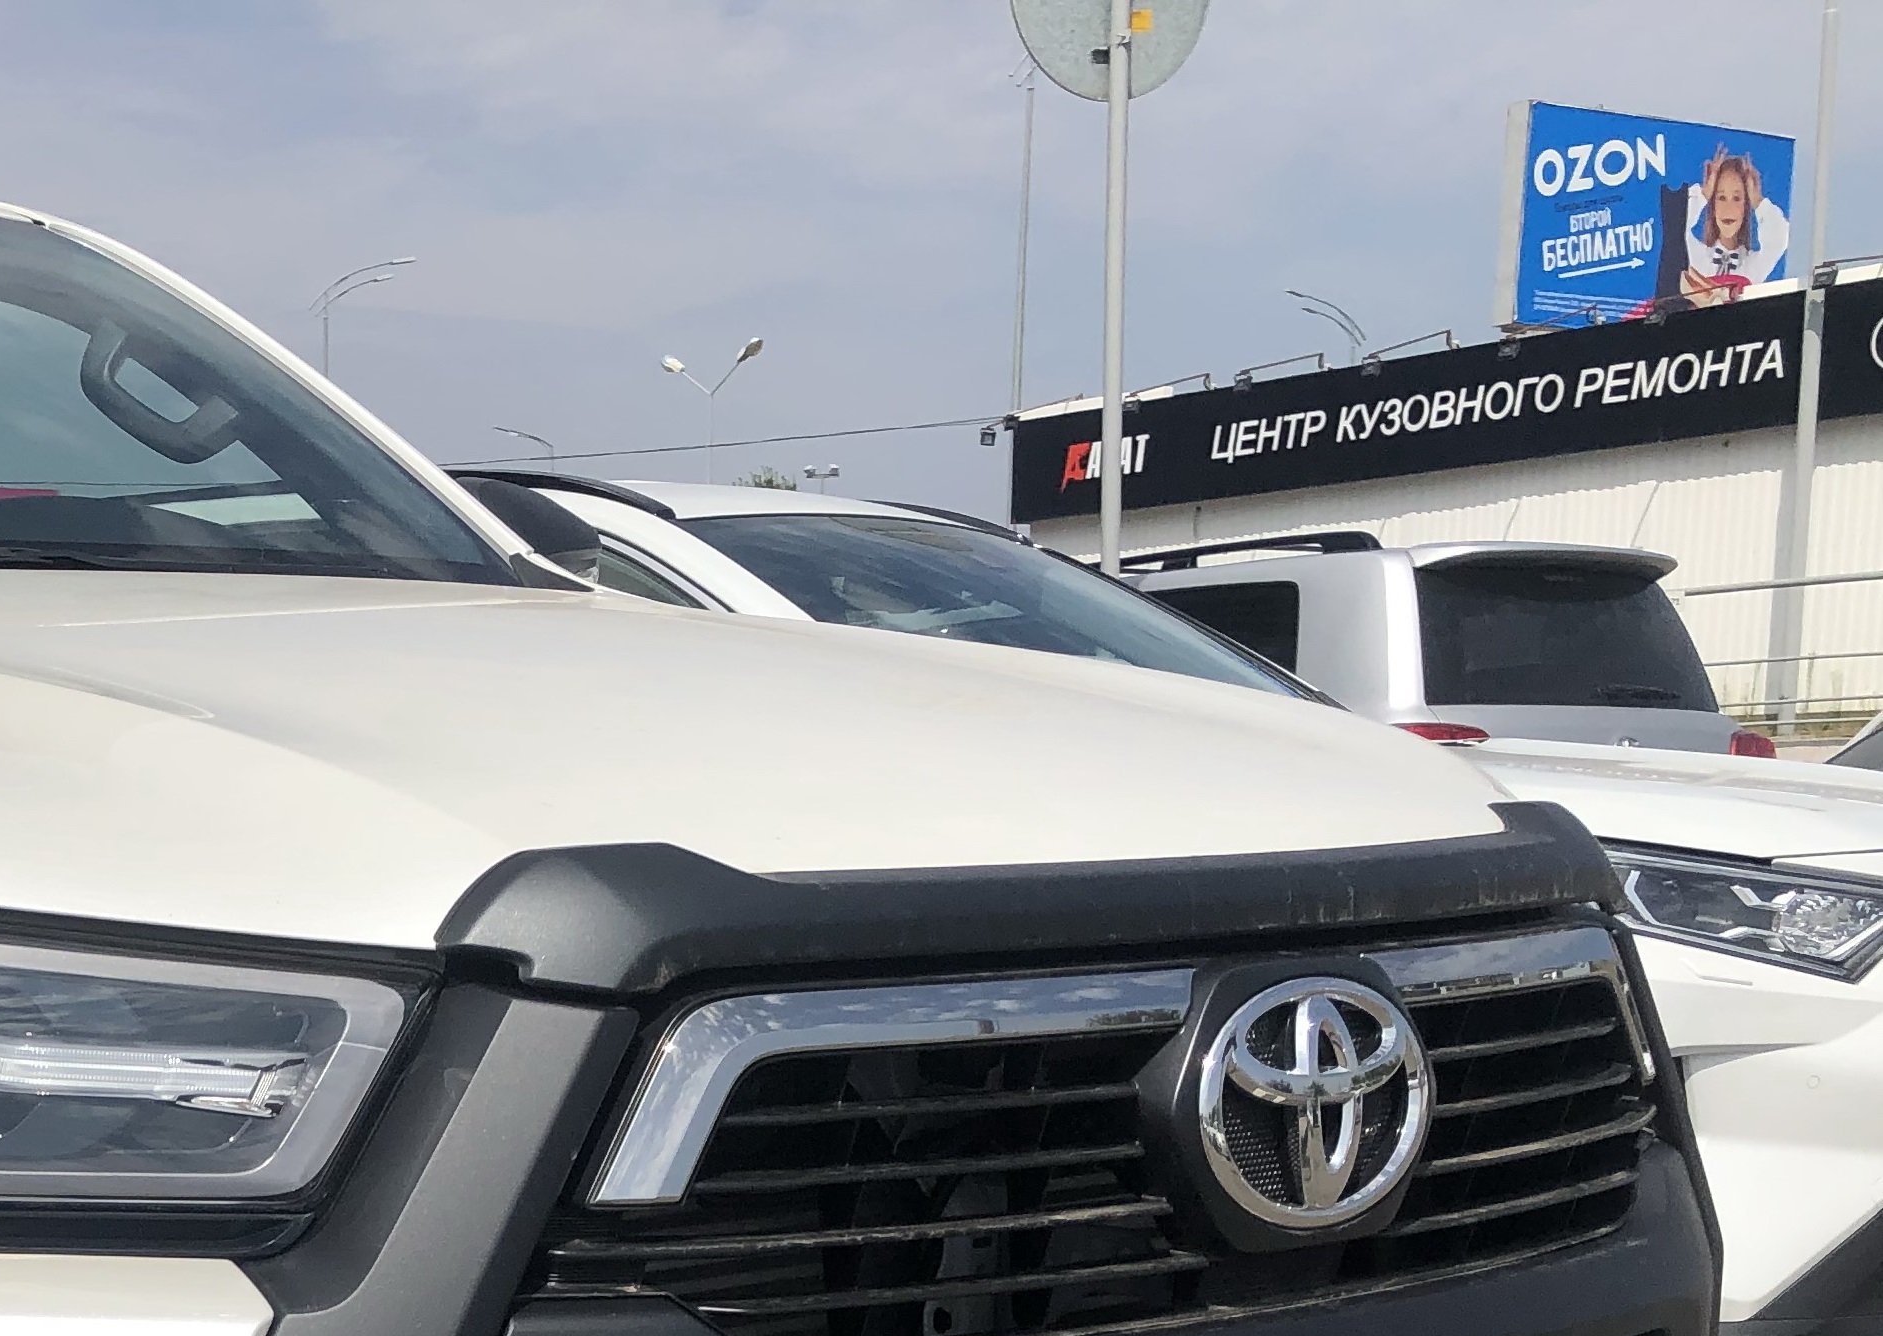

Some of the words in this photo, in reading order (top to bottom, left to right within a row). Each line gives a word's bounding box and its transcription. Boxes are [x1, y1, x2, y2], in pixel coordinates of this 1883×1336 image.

[1533, 133, 1666, 197] OZON
[1542, 220, 1654, 272] БЕСПЛАТНО
[1210, 410, 1328, 464] ЦЕНТР
[1335, 373, 1565, 443] КУЗОВНОГО
[1573, 338, 1785, 409] РЕМОНТА
